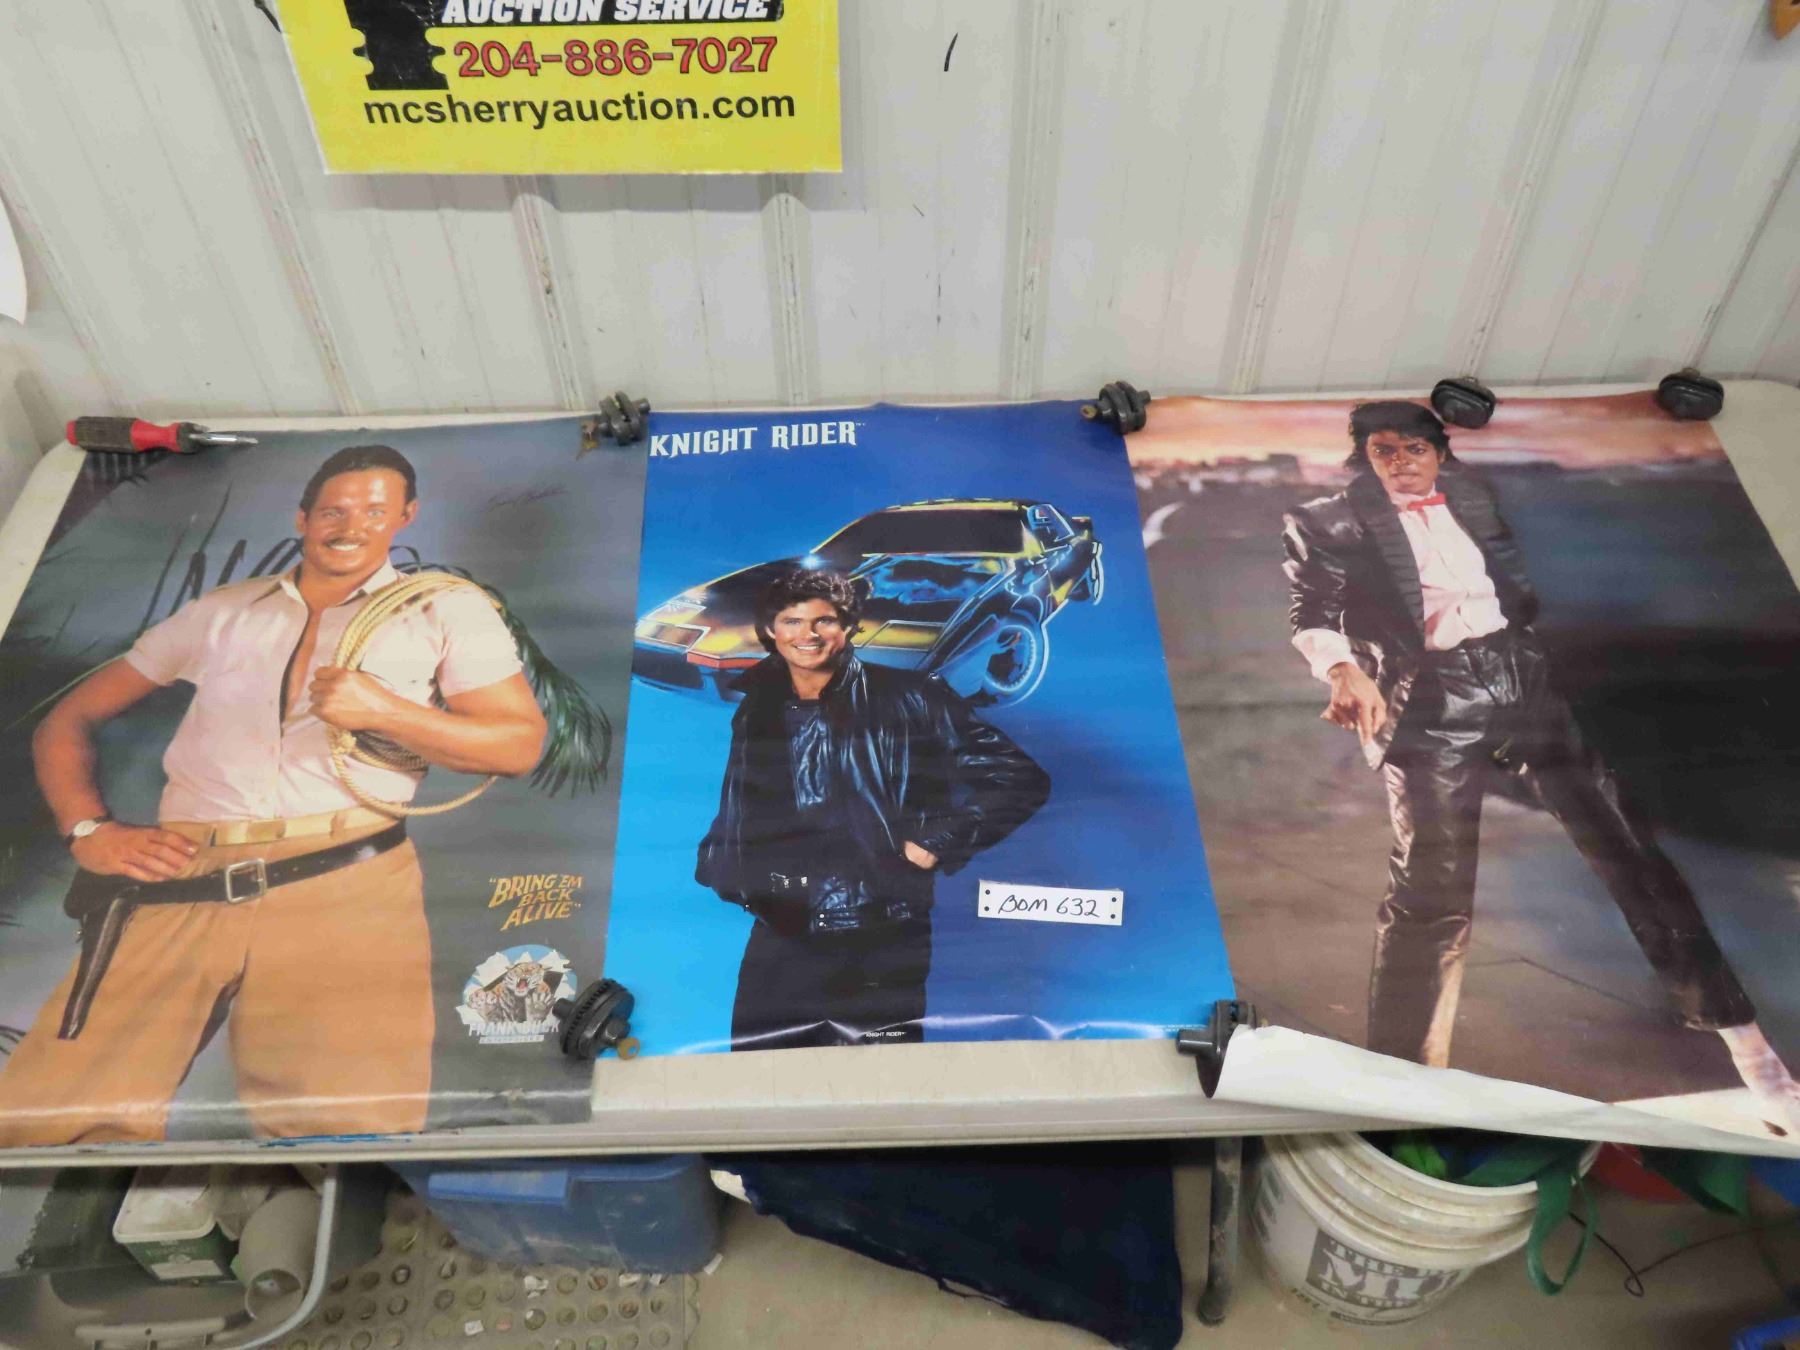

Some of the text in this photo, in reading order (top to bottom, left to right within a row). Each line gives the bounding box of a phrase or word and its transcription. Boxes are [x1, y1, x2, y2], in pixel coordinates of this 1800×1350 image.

[441, 0, 771, 24] AUCTION SERVICE
[453, 36, 778, 78] 204-886-7027
[363, 91, 796, 130] mcsherryauction.com
[649, 427, 758, 459] KNIGHT
[518, 888, 575, 908] BACK
[998, 895, 1100, 918] BOM 632
